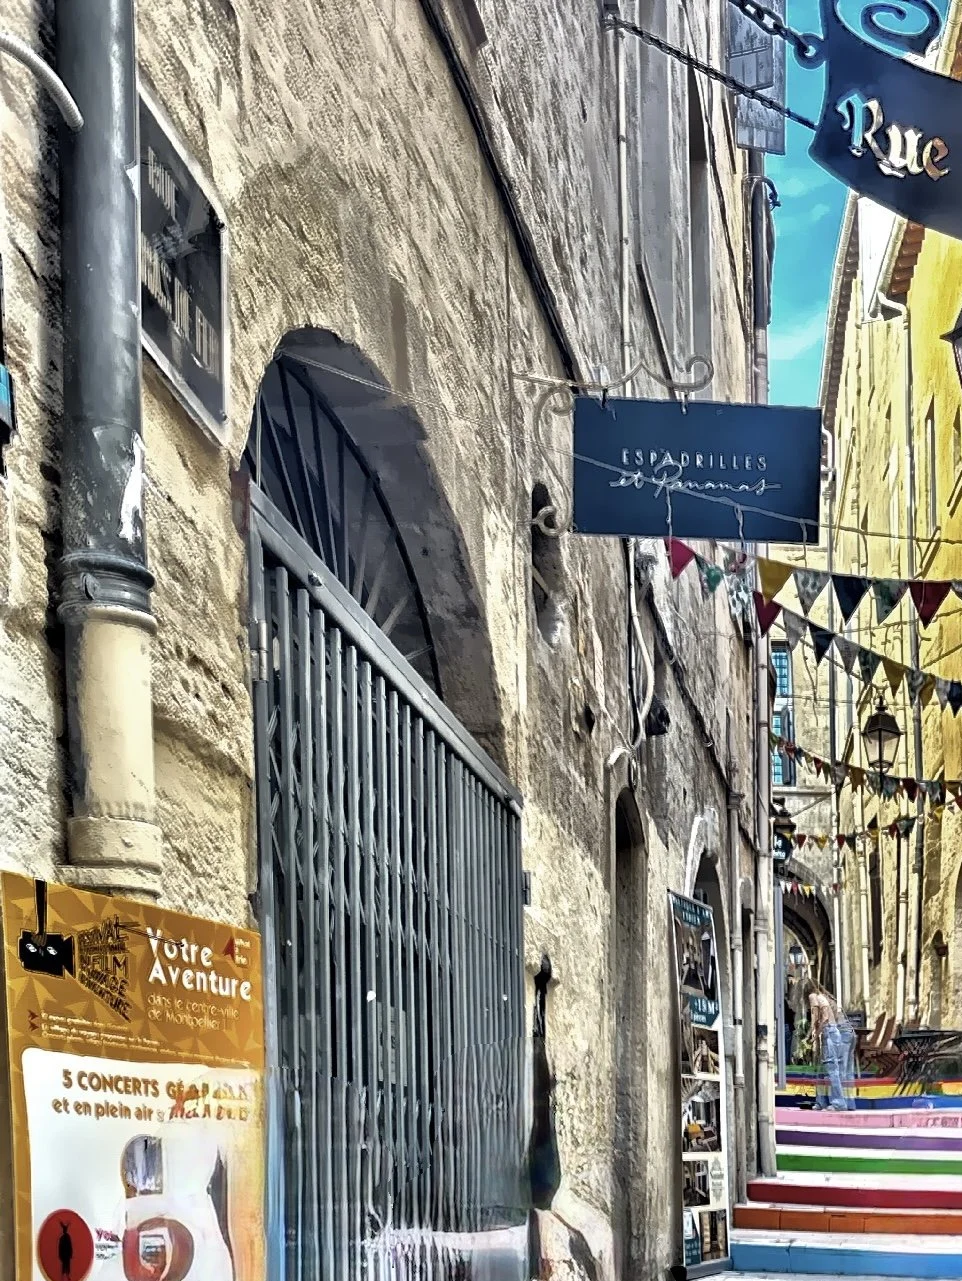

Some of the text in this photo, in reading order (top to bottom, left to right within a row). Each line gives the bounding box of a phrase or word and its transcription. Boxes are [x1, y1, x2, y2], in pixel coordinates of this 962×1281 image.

[836, 96, 953, 182] Rue
[621, 447, 768, 472] ESPADRILLES
[146, 926, 214, 969] Votre
[148, 956, 252, 1002] Aventure
[62, 1068, 160, 1098] 5 CONCERTS
[52, 1097, 71, 1115] et
[73, 1101, 92, 1116] en
[95, 1099, 132, 1120] plein
[134, 1103, 154, 1121] air
